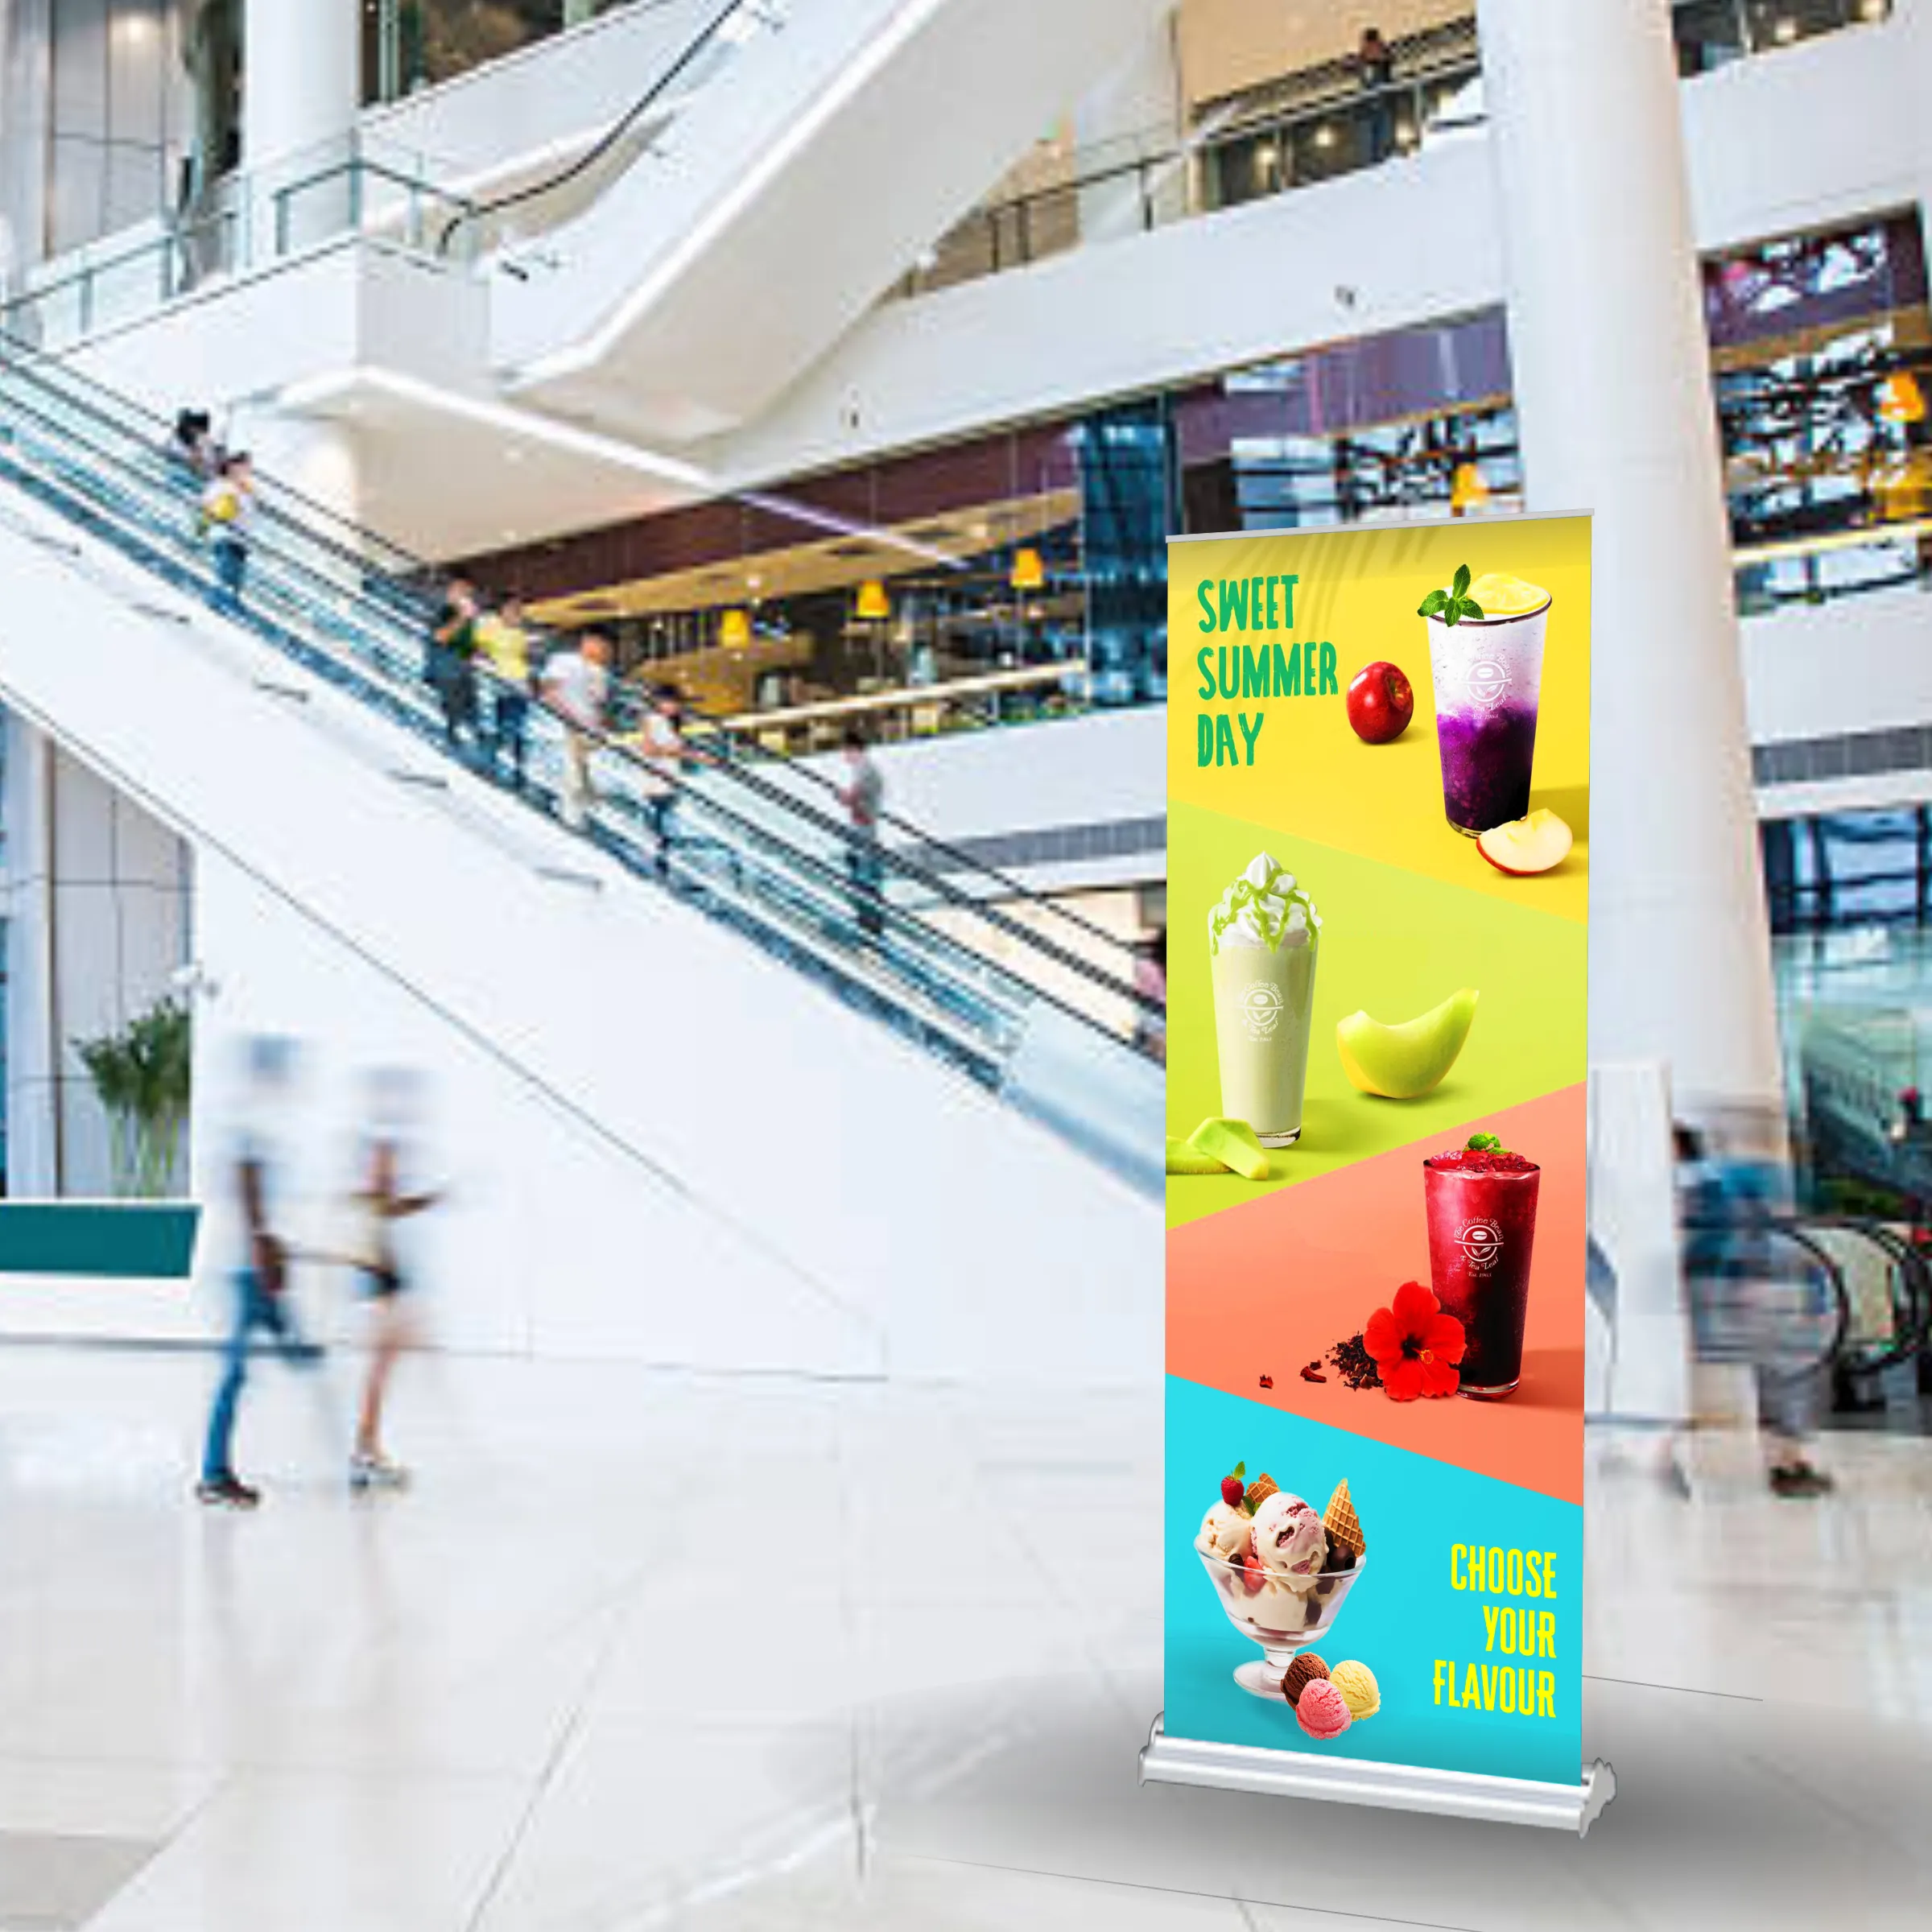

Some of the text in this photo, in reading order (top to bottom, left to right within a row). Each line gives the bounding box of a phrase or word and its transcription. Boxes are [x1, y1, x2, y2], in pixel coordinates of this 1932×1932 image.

[1197, 574, 1299, 634] SWEET
[1197, 642, 1339, 700] SUMMER
[1197, 712, 1264, 767] DAY
[1462, 1216, 1488, 1227] Coffee
[1489, 1218, 1504, 1241] Bean
[1468, 1260, 1480, 1270] Tea
[1481, 1253, 1499, 1269] Leaf
[1451, 1543, 1557, 1599] CHOOSE
[1482, 1605, 1557, 1658] YOUR
[1433, 1659, 1556, 1718] FLAVOUR
